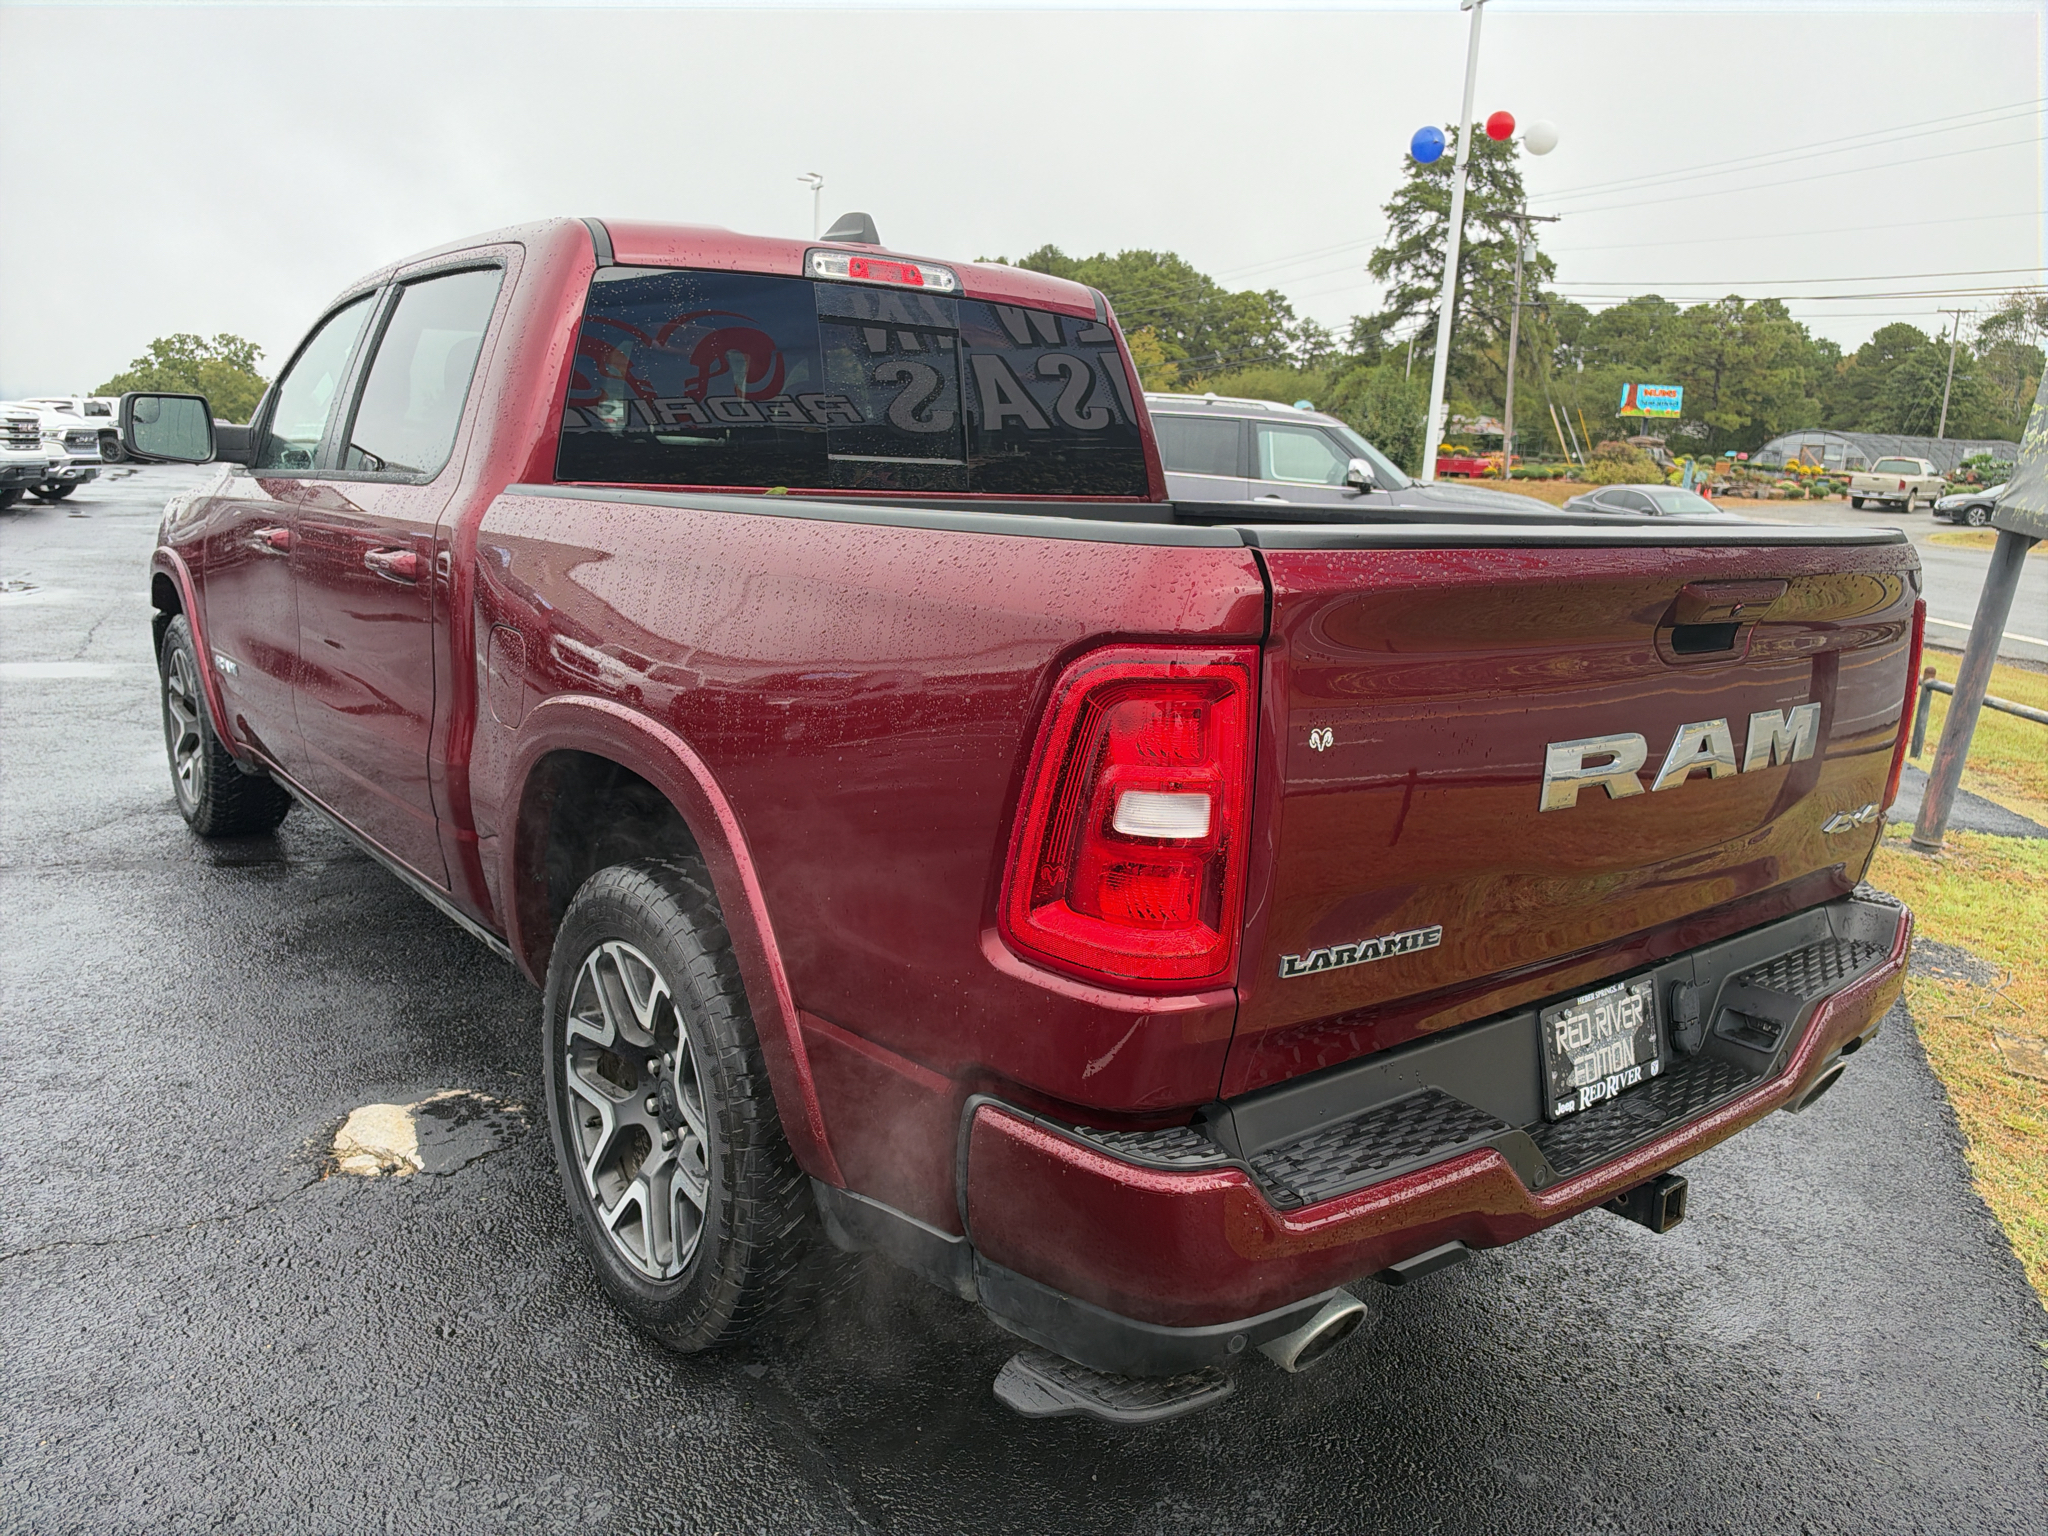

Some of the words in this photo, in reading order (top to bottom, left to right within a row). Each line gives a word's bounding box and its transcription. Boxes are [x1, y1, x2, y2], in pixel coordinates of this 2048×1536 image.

[1539, 701, 1821, 813] RAM
[1278, 924, 1443, 979] LARAMIE
[1555, 1013, 1592, 1055] RED
[1595, 994, 1644, 1040] RIVER
[1574, 1036, 1636, 1087] EDITION
